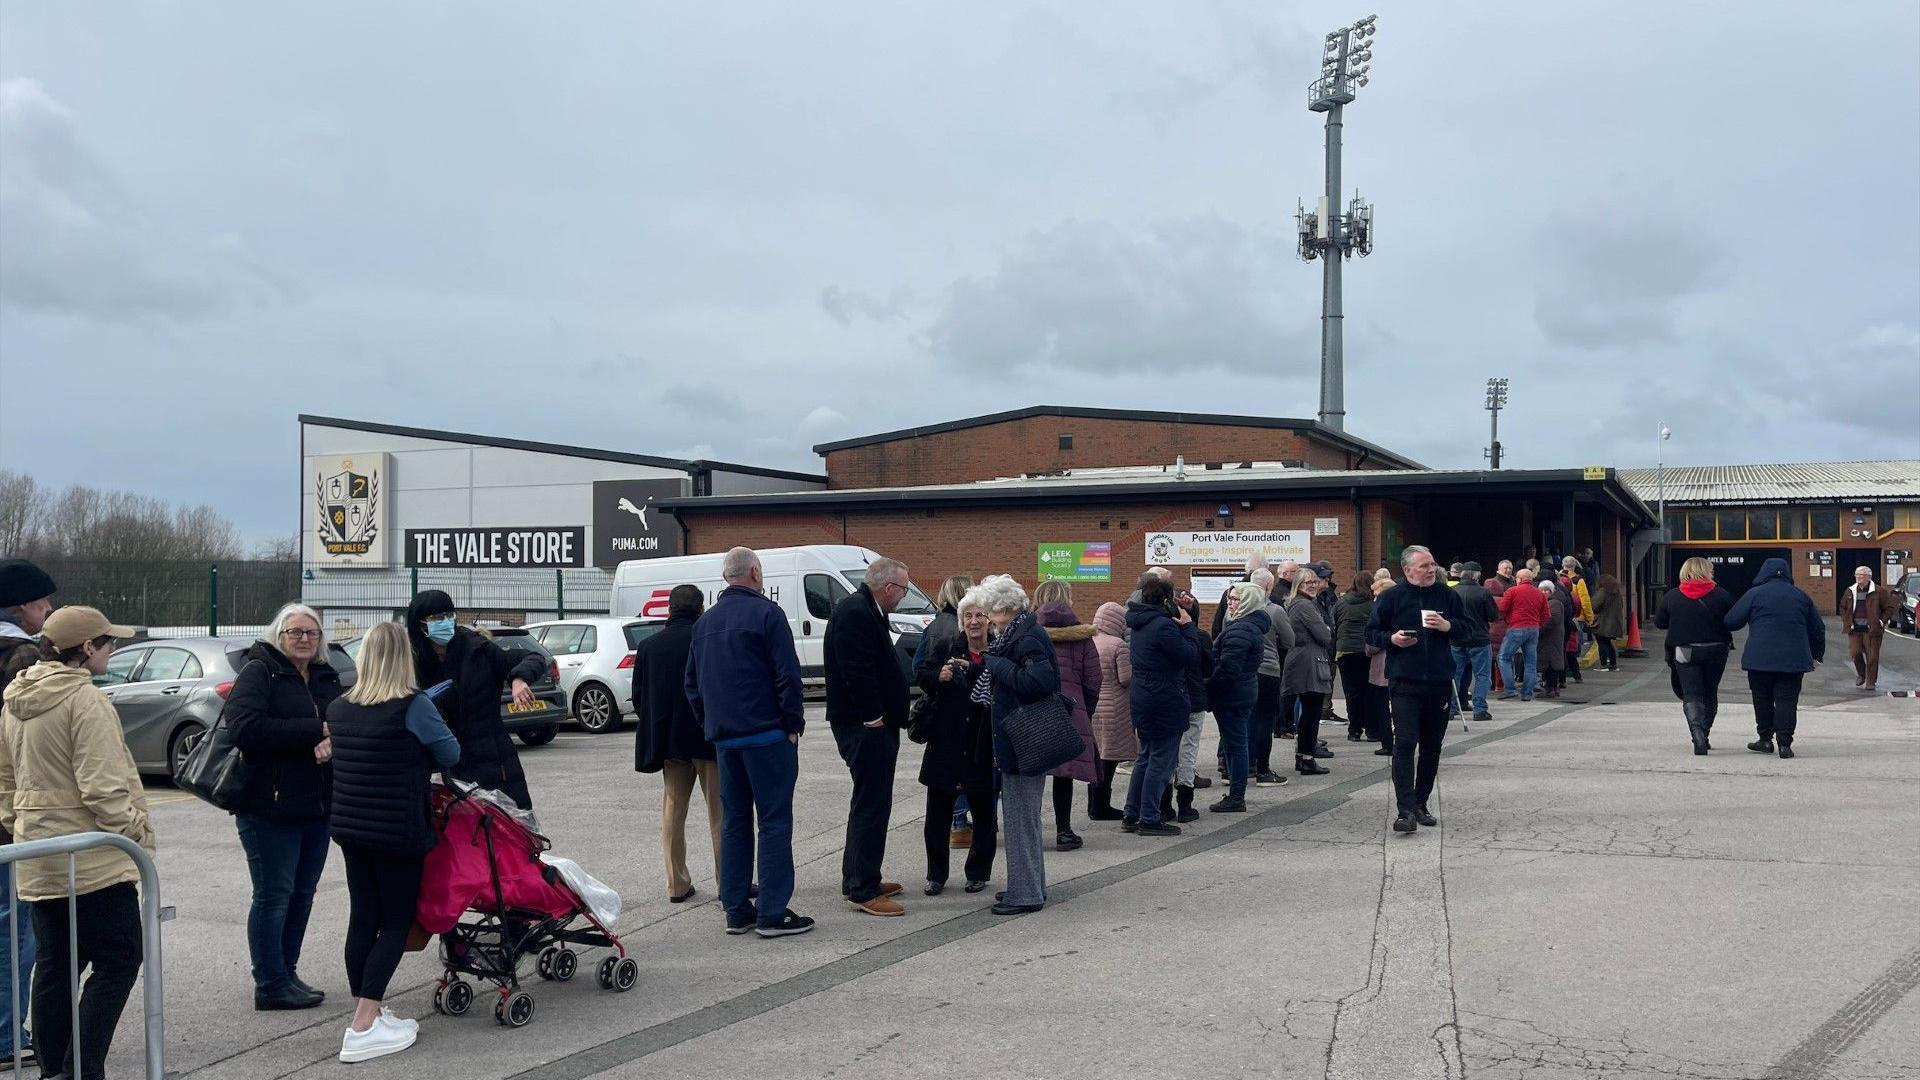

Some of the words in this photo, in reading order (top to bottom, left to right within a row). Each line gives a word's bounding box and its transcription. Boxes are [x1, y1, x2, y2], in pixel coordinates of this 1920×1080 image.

[612, 537, 658, 551] PUMA.COM
[1147, 534, 1175, 547] FOUNDATION
[1192, 534, 1211, 543] Port
[1213, 533, 1234, 542] Vale
[1236, 533, 1291, 542] Foundation
[327, 544, 342, 552] PORT
[343, 544, 357, 552] VALE
[414, 533, 450, 563] THE
[455, 532, 501, 563] VALE
[508, 532, 574, 563] STORE
[1178, 546, 1214, 556] Engage
[1222, 546, 1254, 556] Inspire
[1263, 545, 1304, 554] Motivate
